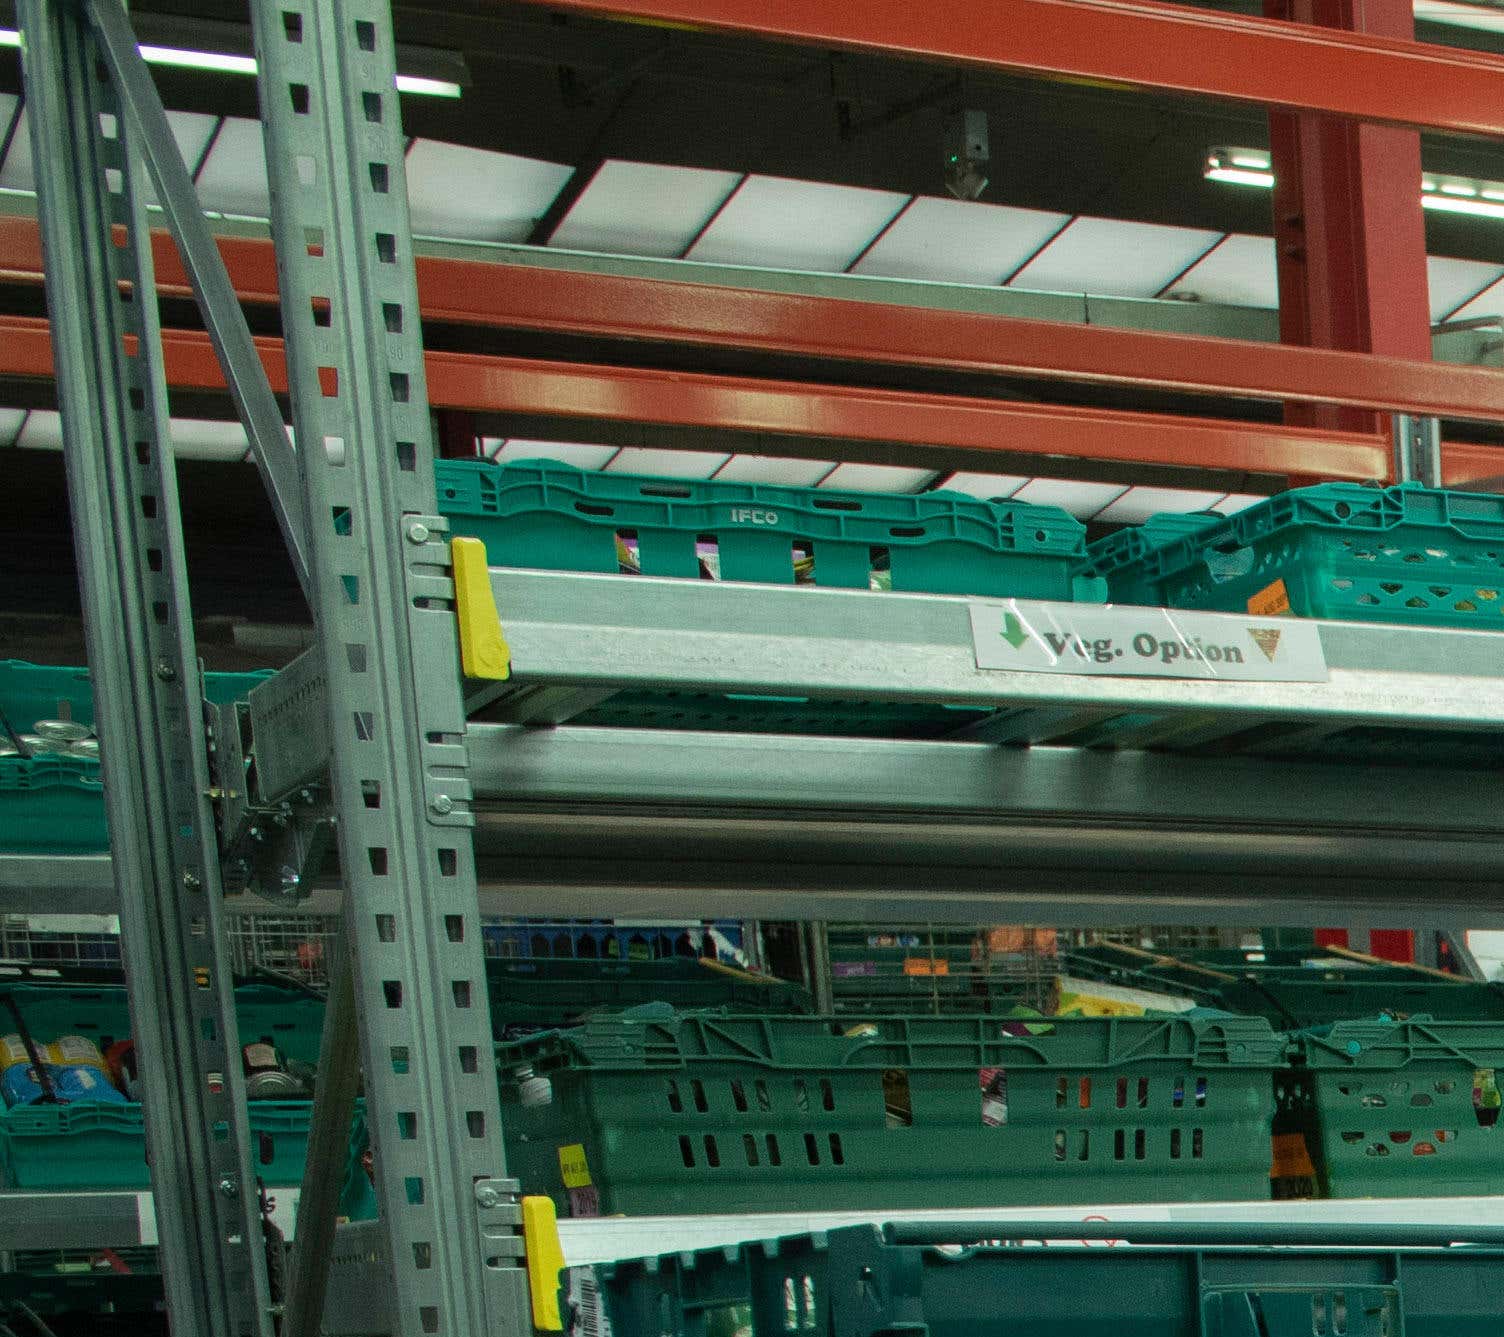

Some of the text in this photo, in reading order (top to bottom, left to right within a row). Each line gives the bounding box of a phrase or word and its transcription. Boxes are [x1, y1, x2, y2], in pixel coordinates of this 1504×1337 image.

[731, 508, 779, 525] IFCO
[1044, 631, 1245, 665] Veg. Option
